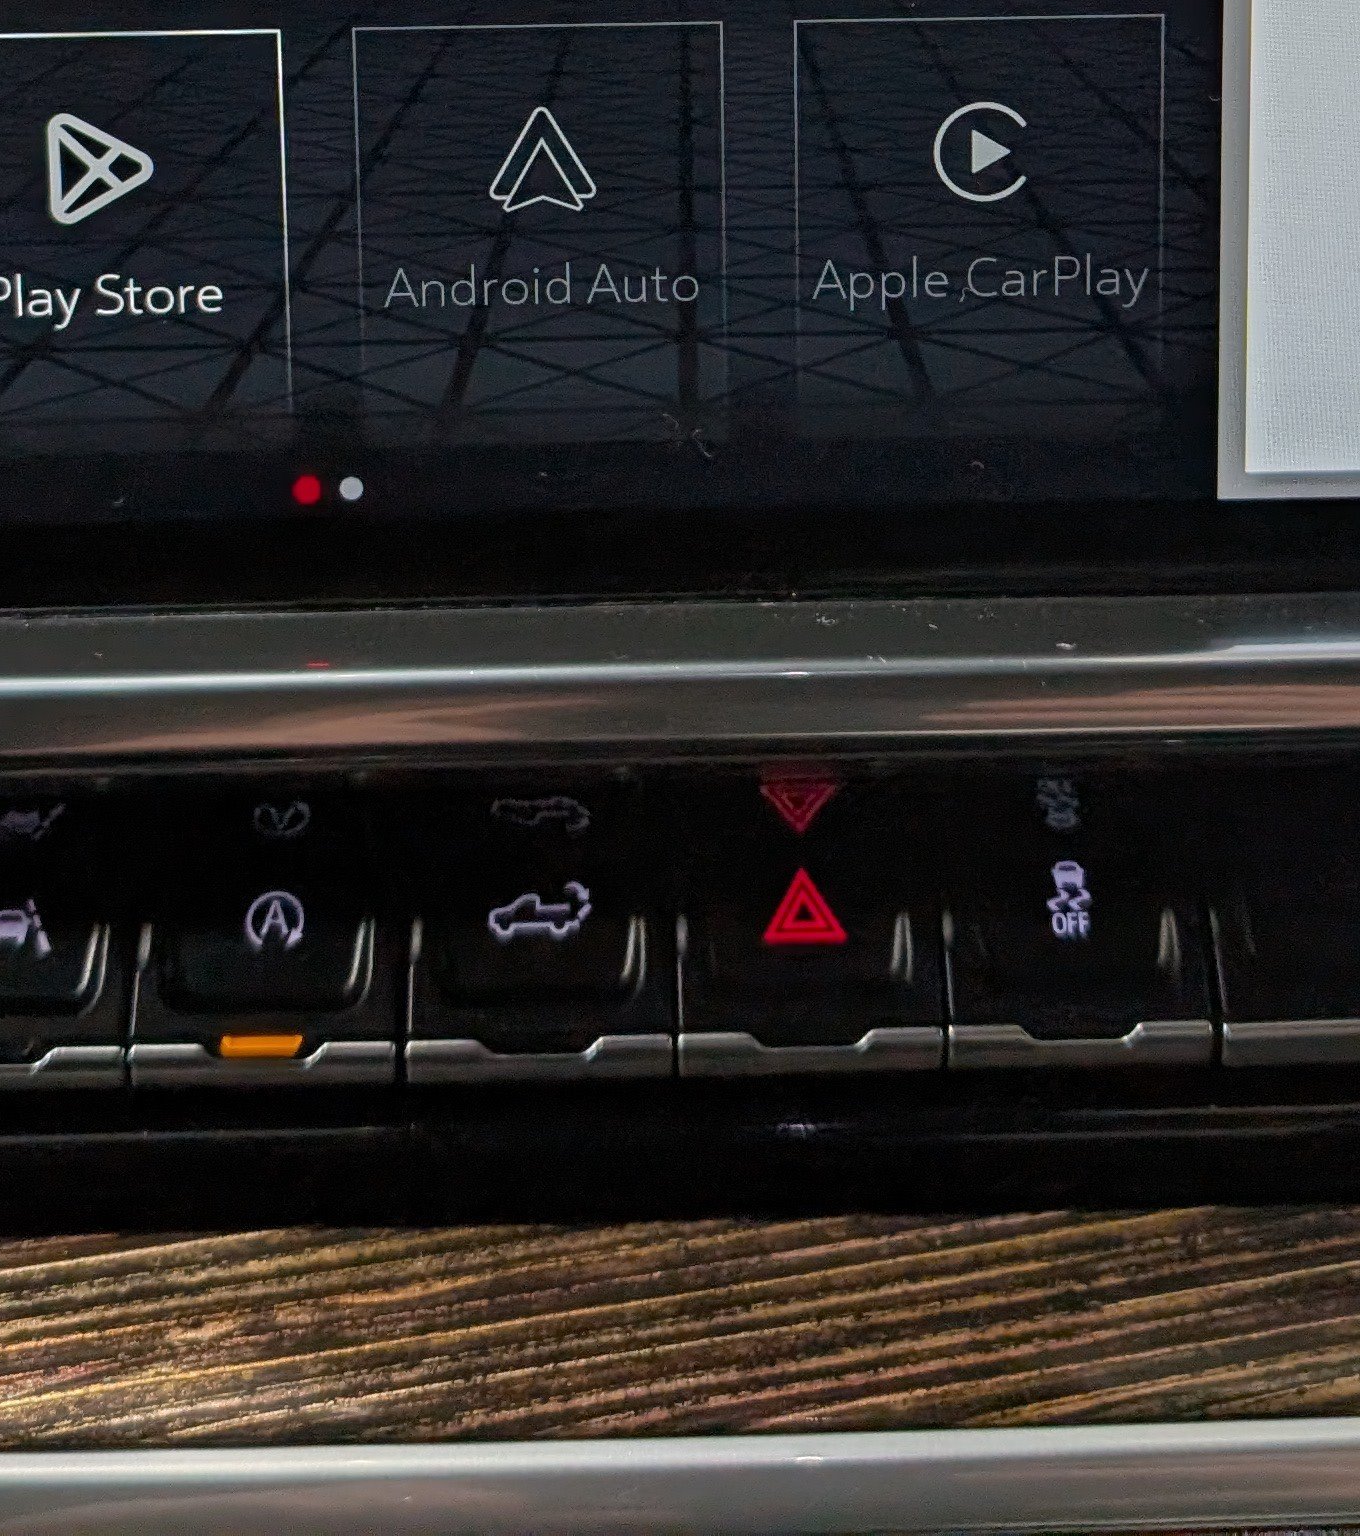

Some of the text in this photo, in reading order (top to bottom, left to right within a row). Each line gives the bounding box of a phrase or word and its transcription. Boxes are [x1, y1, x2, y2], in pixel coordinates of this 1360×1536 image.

[96, 274, 222, 315] Store
[384, 262, 698, 307] Android Auto
[812, 253, 1149, 311] Apple CarPlay
[1050, 911, 1090, 936] OFF
